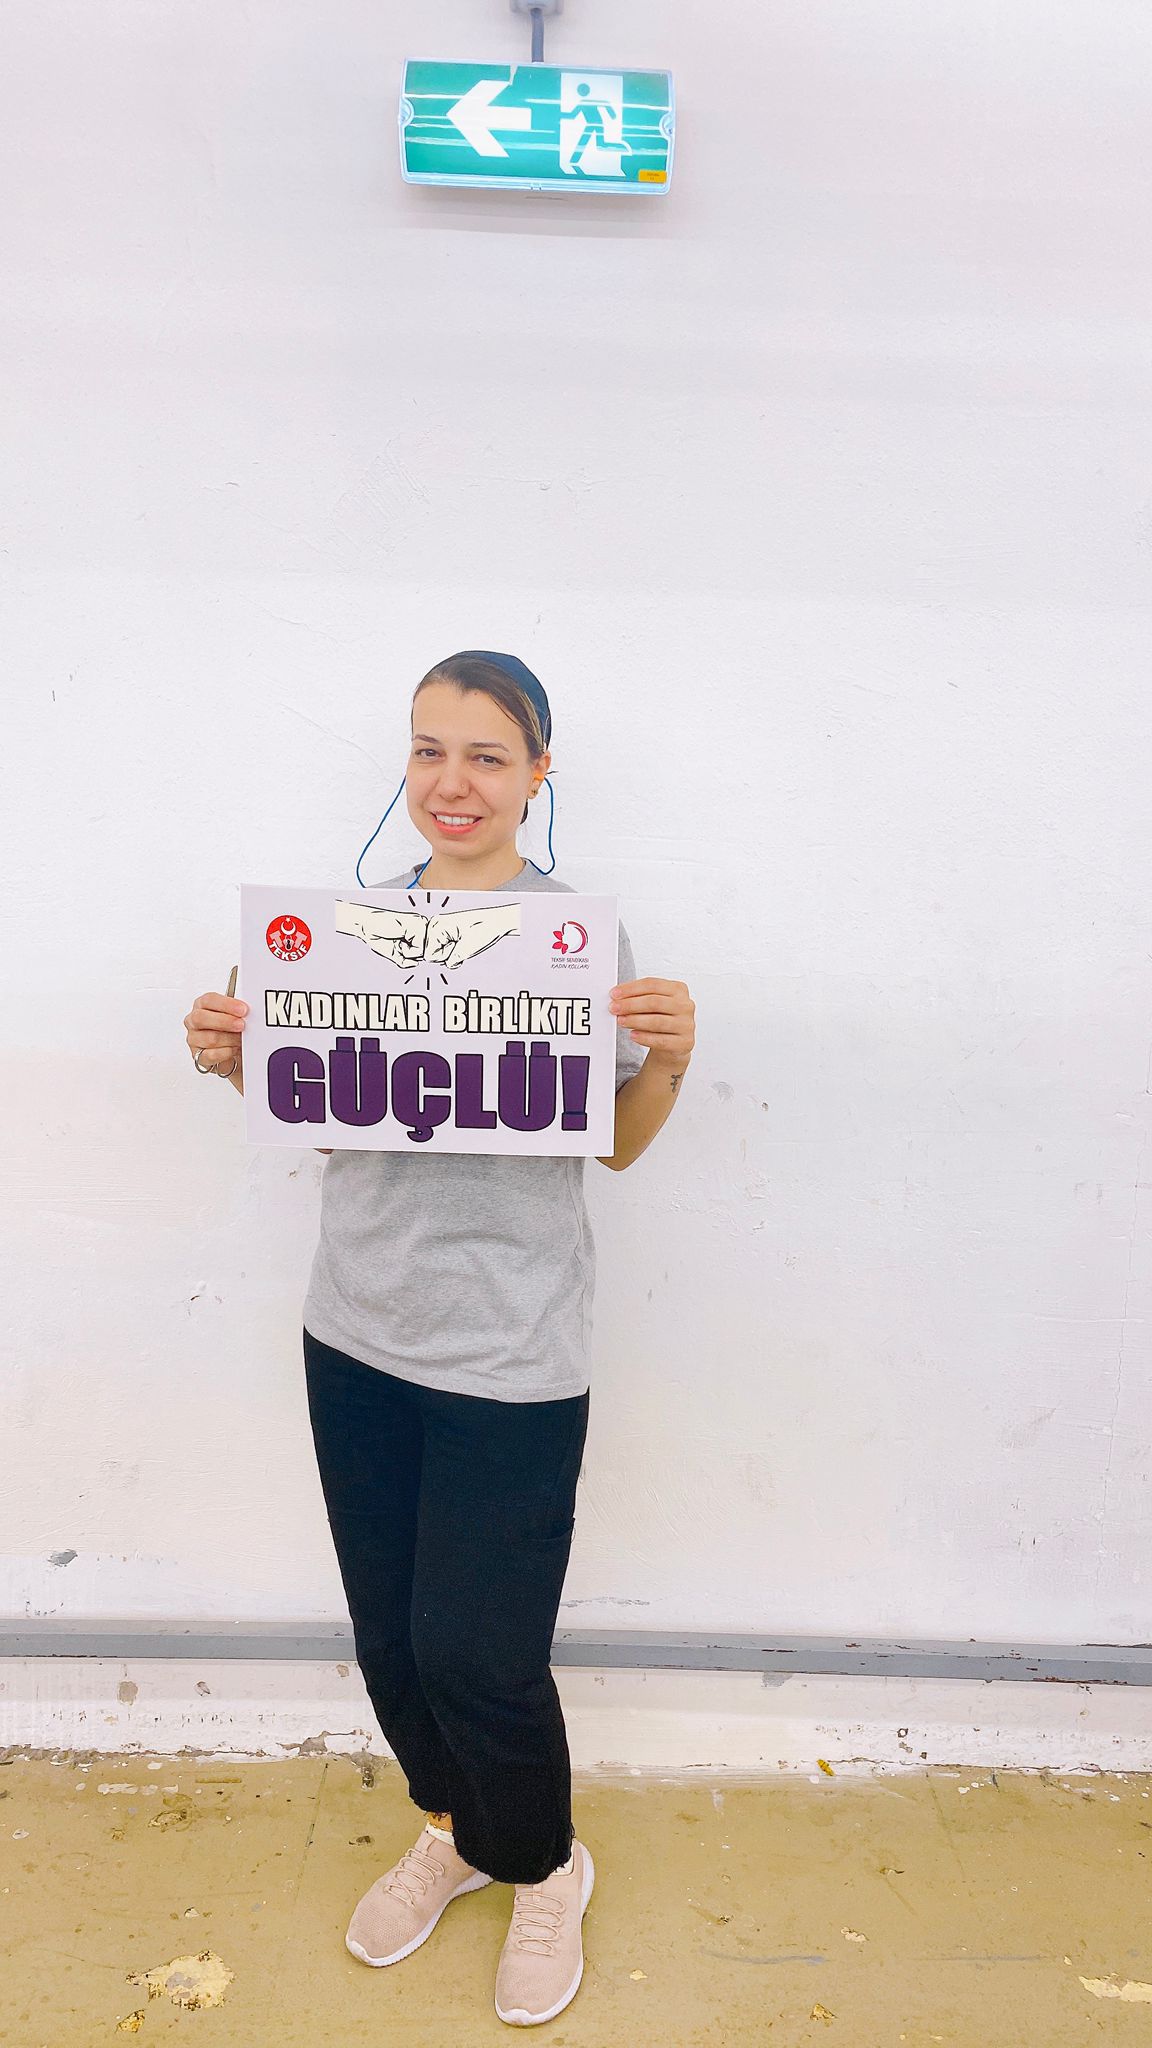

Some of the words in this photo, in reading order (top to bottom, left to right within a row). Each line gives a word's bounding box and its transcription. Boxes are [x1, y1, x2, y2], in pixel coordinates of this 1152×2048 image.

[269, 940, 308, 961] TEKSİF
[265, 990, 430, 1032] KADINLAR
[443, 990, 591, 1035] BİRLİKTE
[268, 1036, 590, 1142] GÜÇLÜ!
